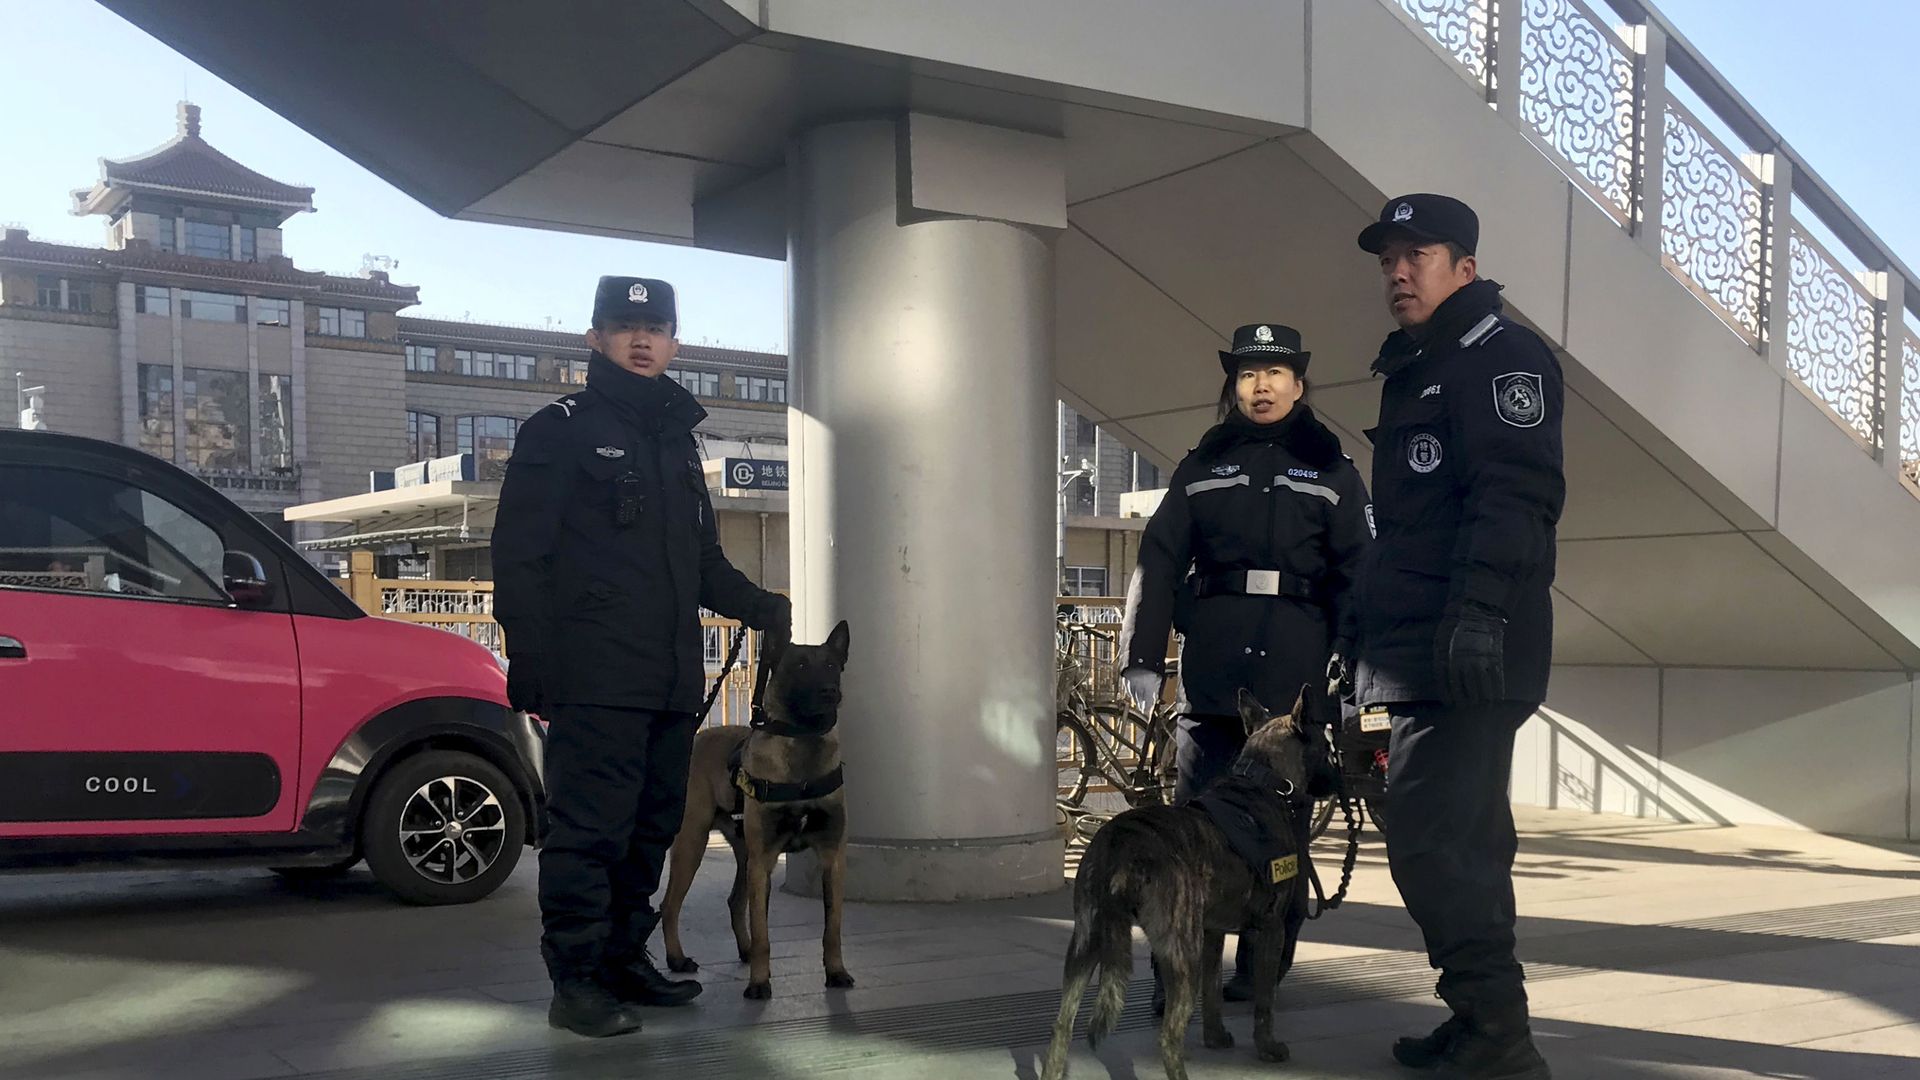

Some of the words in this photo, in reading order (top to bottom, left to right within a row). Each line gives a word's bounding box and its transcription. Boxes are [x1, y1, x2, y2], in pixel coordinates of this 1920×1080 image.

[761, 464, 787, 477] 地铁
[85, 776, 157, 793] COOL
[1273, 859, 1298, 878] Police
